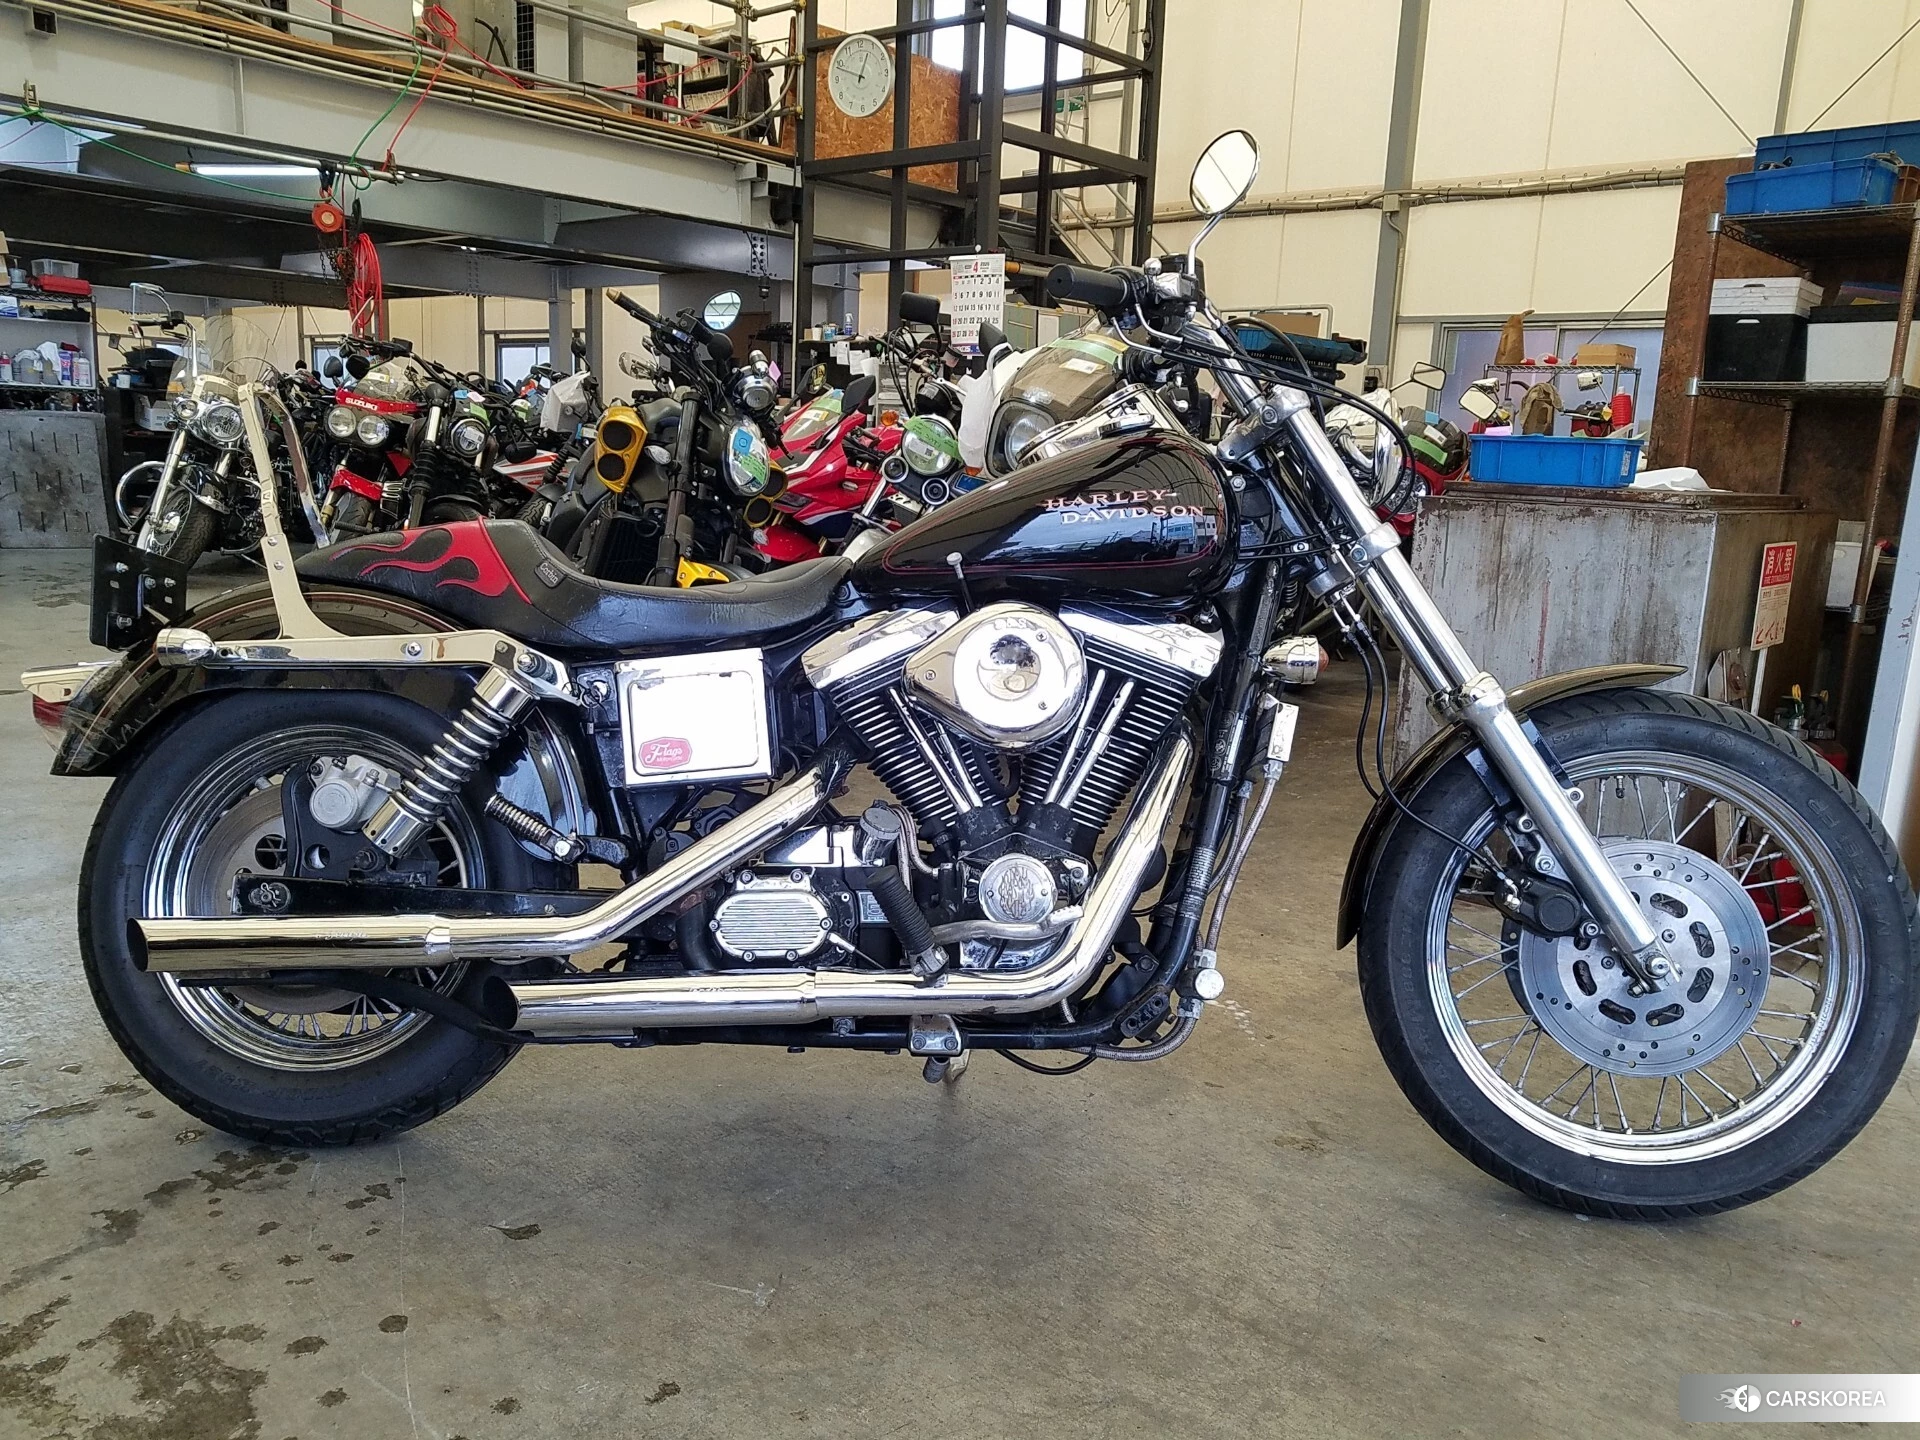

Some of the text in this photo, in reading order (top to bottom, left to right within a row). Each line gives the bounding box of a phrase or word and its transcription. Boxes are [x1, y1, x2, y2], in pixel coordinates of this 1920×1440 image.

[857, 40, 863, 48] 12
[973, 261, 978, 273] 4
[345, 397, 378, 411] SUZUKI
[1061, 505, 1205, 525] DAVIDSON
[1766, 548, 1793, 574] 消火器
[540, 562, 558, 583] Corbin
[645, 743, 683, 763] Flags
